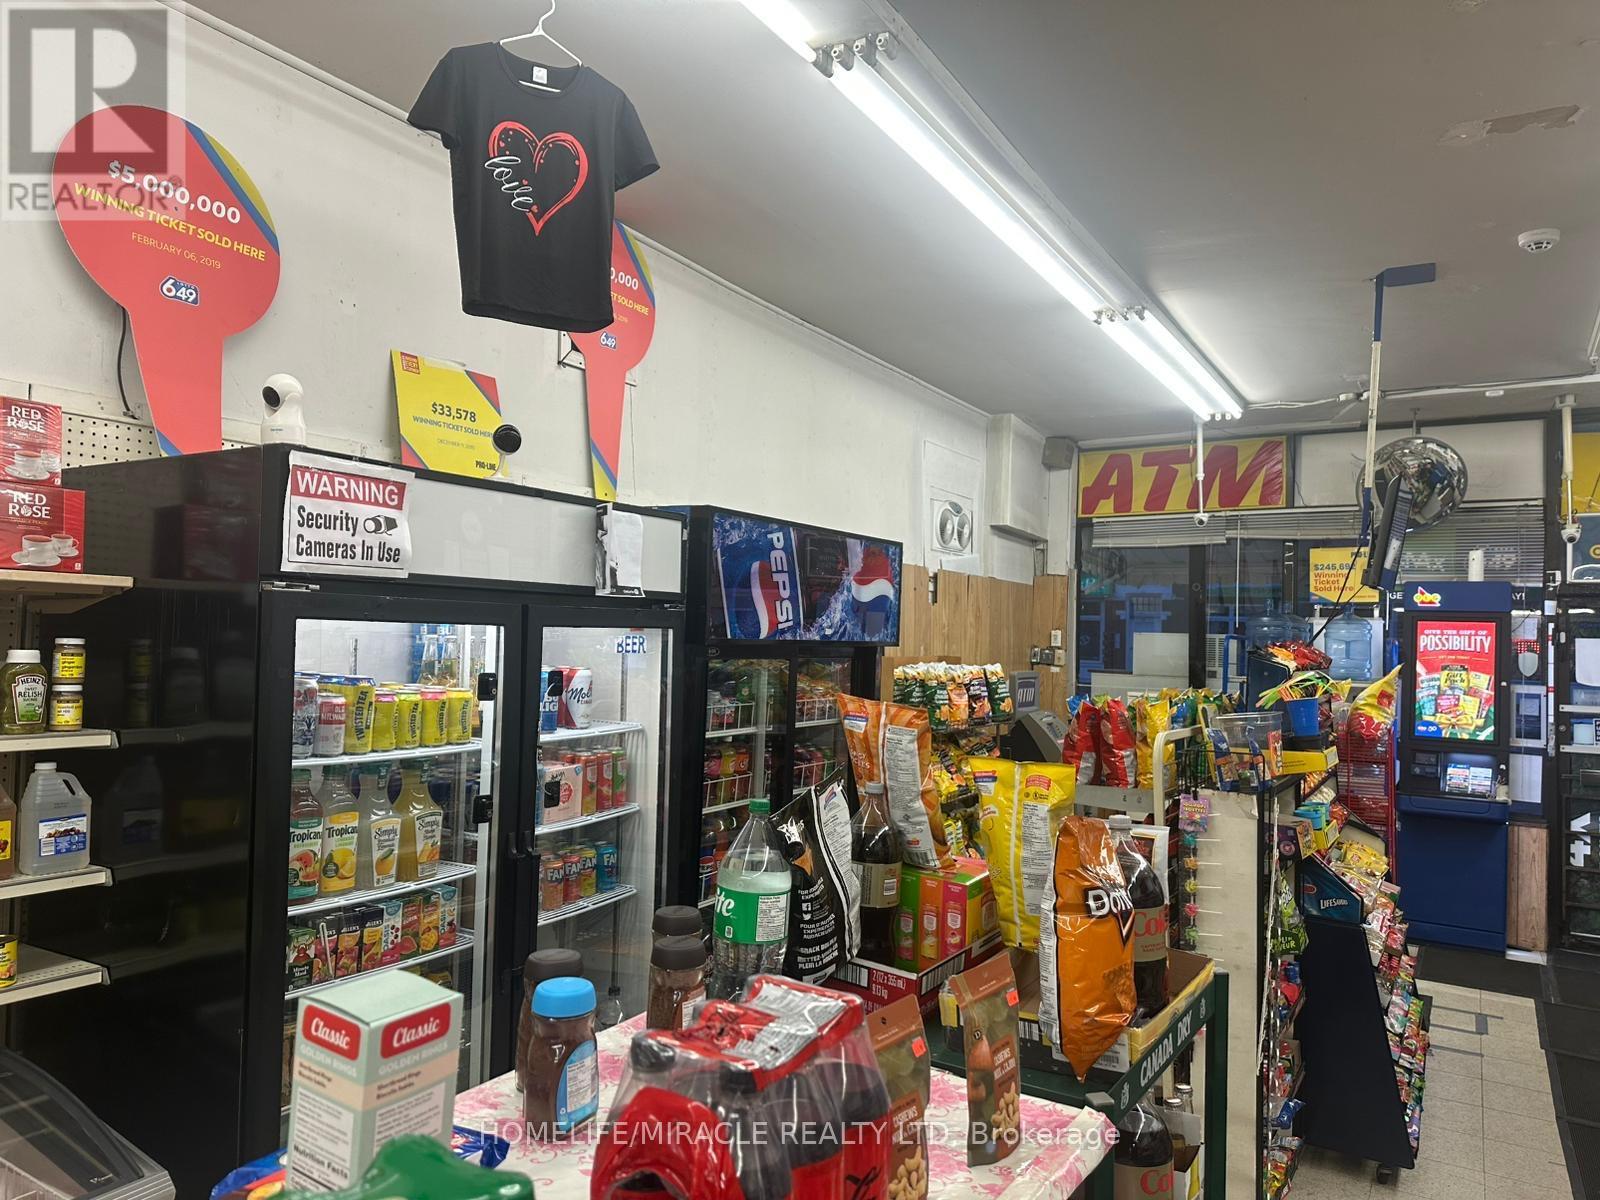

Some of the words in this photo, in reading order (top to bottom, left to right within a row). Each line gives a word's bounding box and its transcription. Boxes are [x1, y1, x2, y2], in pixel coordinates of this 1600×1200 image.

[108, 159, 241, 224] $5,000,000
[485, 156, 534, 212] love
[74, 182, 145, 219] WINNING
[147, 208, 197, 237] TICKET
[197, 225, 232, 250] SOLD
[233, 239, 266, 262] HERE
[131, 232, 182, 257] FEBRUARY
[183, 249, 200, 265] 06,
[199, 256, 222, 270] 2019
[617, 295, 634, 309] SOLD
[634, 303, 649, 316] HERE
[7, 415, 46, 433] ROSE
[11, 405, 42, 421] RED
[412, 415, 442, 428] WINNING
[442, 421, 464, 432] TICKET
[463, 427, 480, 435] SOLD
[431, 402, 477, 423] $33,578
[297, 470, 398, 506] WARNING
[1082, 440, 1284, 516] ATM
[8, 502, 52, 519] ROSE
[13, 490, 47, 506] RED
[297, 505, 359, 537] Security
[296, 533, 357, 560] Cameras
[361, 540, 374, 561] In
[378, 541, 400, 563] Use
[767, 531, 794, 631] PEPSI
[1314, 578, 1340, 586] Ticket
[616, 635, 646, 654] BEER
[1420, 634, 1492, 654] POSSIBILITY
[357, 690, 369, 706] TEA
[1017, 686, 1035, 703] ATM
[354, 706, 366, 741] TWISTED
[374, 825, 398, 840] Simply
[887, 974, 897, 987] 355
[311, 1017, 351, 1050] Classic
[392, 1016, 441, 1048] Classic
[300, 1043, 332, 1065] GOLDEN
[332, 1058, 357, 1078] RINGS
[378, 1053, 421, 1076] GOLDEN
[420, 1041, 449, 1061] RINGS
[1139, 1036, 1174, 1088] CANADA
[1177, 1009, 1193, 1047] DRY
[893, 1105, 919, 1128] CASHEWS
[293, 1143, 326, 1168] Nutrition
[326, 1159, 349, 1180] Facts
